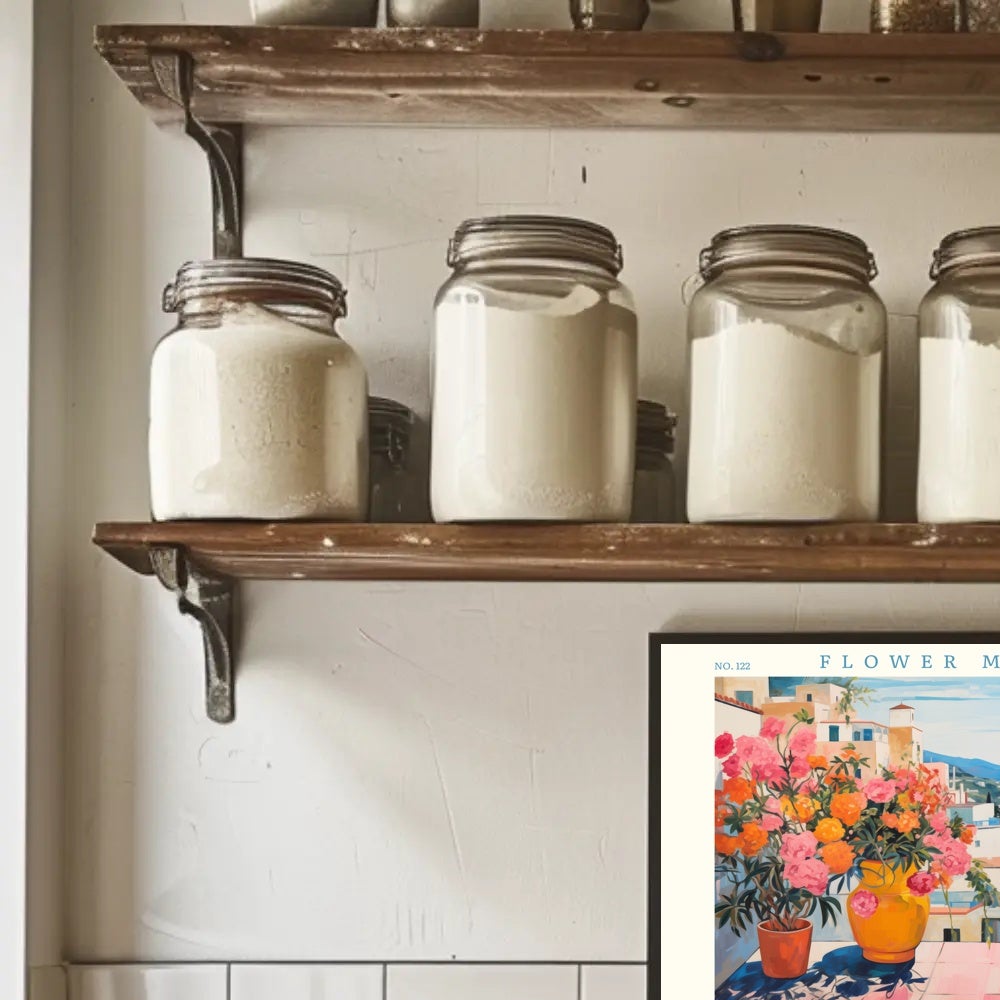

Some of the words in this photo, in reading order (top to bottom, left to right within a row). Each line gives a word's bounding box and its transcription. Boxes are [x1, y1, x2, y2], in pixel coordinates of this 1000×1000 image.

[714, 661, 734, 671] NO.
[735, 661, 751, 671] 122
[819, 654, 958, 670] FLOWER
